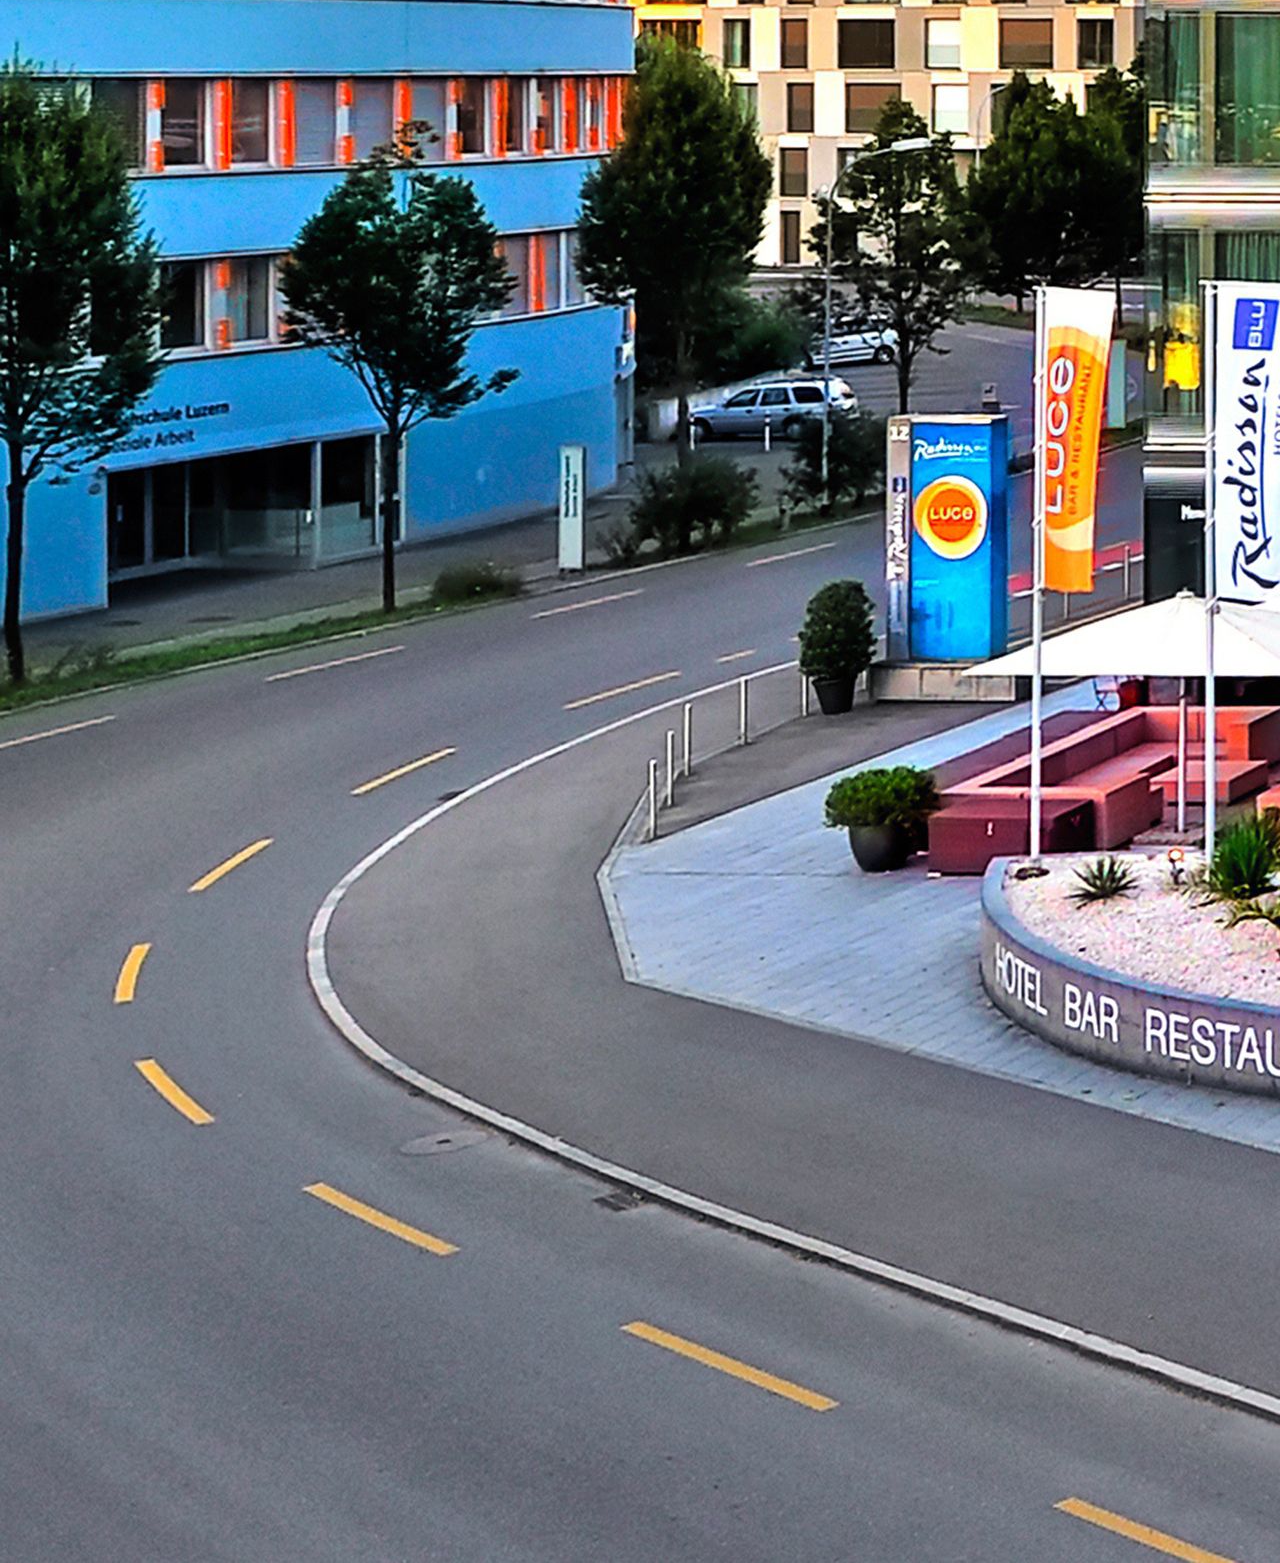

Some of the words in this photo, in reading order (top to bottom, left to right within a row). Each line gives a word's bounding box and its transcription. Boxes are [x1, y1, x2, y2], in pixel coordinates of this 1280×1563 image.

[1248, 300, 1266, 348] BLU
[185, 402, 230, 420] Luzern
[1072, 365, 1092, 463] RESTAURANT
[154, 428, 195, 448] Arbeit
[889, 425, 910, 441] 12
[1223, 358, 1280, 589] Radisson
[1068, 485, 1078, 515] BAR
[995, 942, 1048, 1016] HOTEL
[1064, 983, 1119, 1043] BAR
